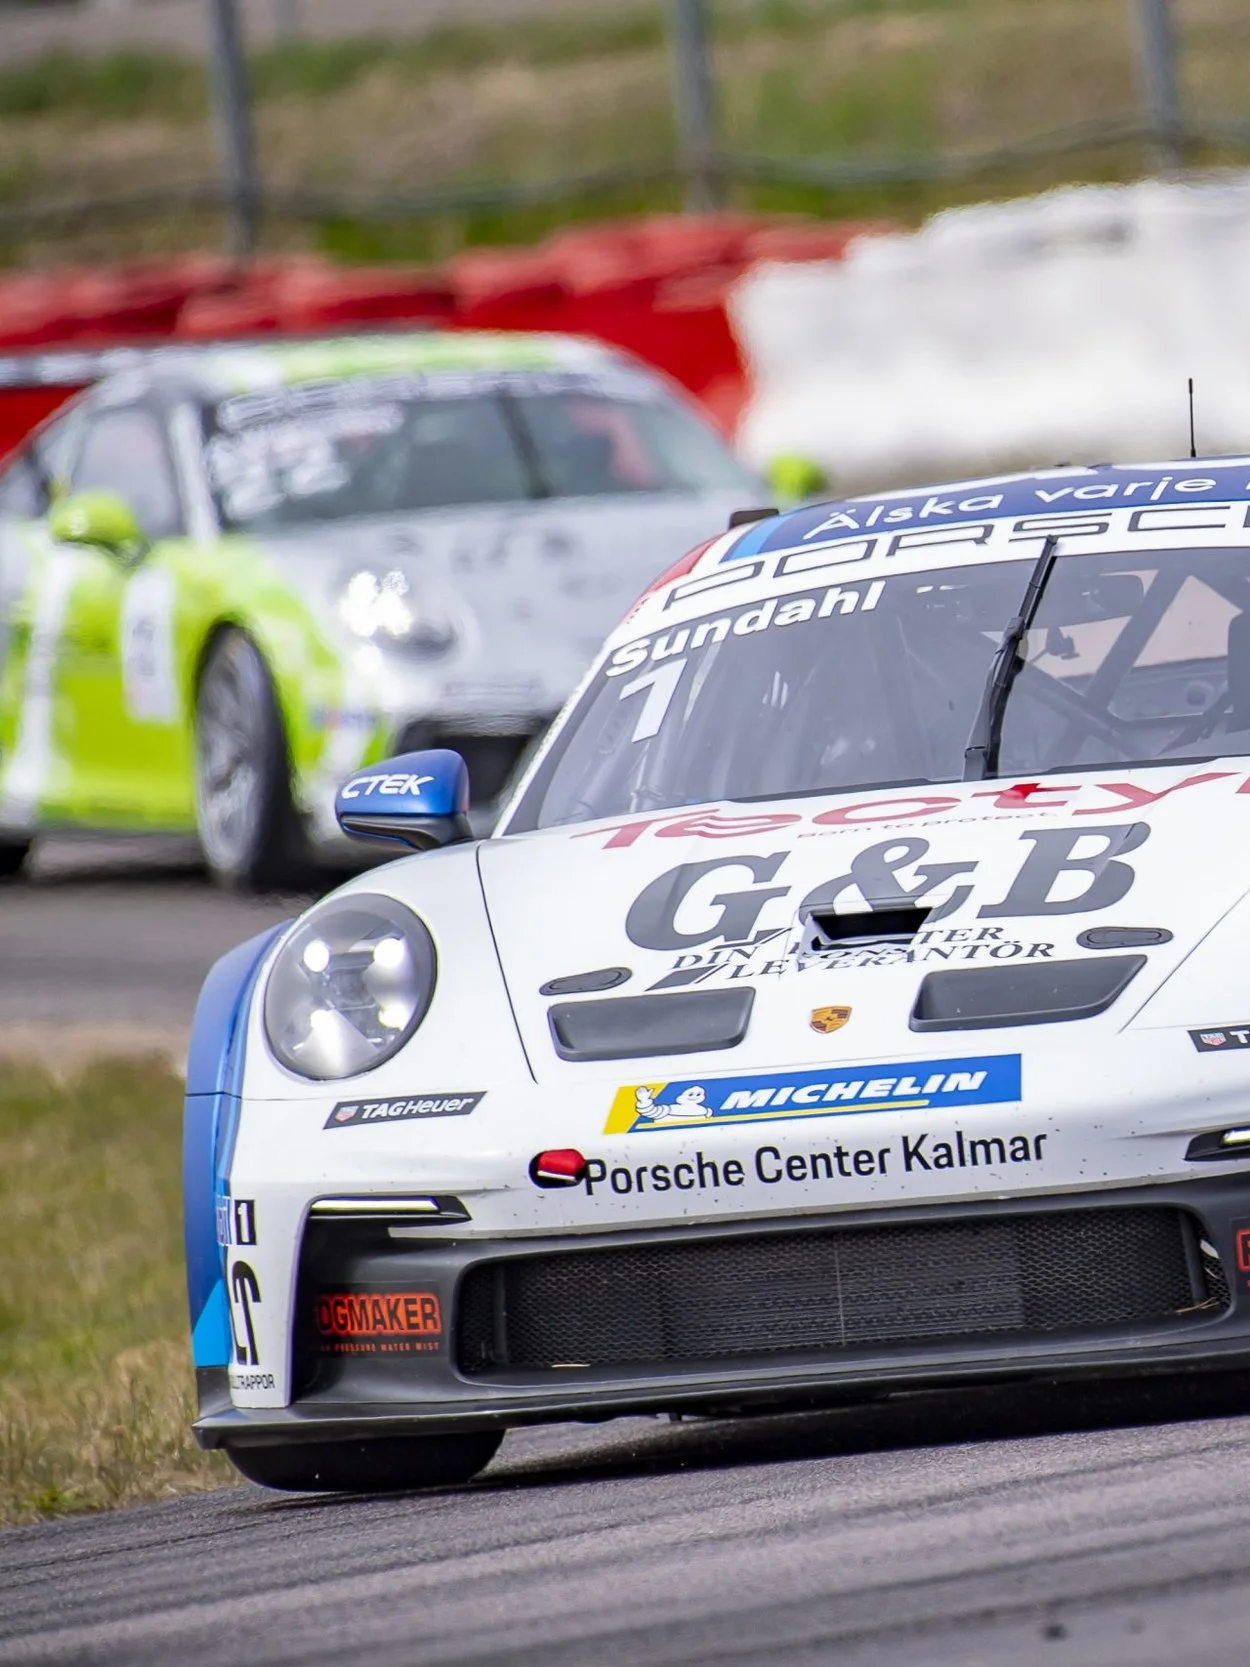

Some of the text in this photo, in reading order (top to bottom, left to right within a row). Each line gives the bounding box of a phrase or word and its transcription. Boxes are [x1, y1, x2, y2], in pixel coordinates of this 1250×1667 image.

[803, 491, 1004, 540] Älska
[1034, 474, 1217, 503] varje
[605, 580, 888, 678] Sundahl
[618, 658, 688, 744] 1
[341, 773, 435, 800] CTEK
[624, 821, 1151, 951] G&B
[672, 944, 758, 971] DIN
[719, 1069, 988, 1113] MICHELIN
[585, 1130, 1049, 1196] Porsche Center Kalmar
[319, 1296, 438, 1331] OGMAKER
